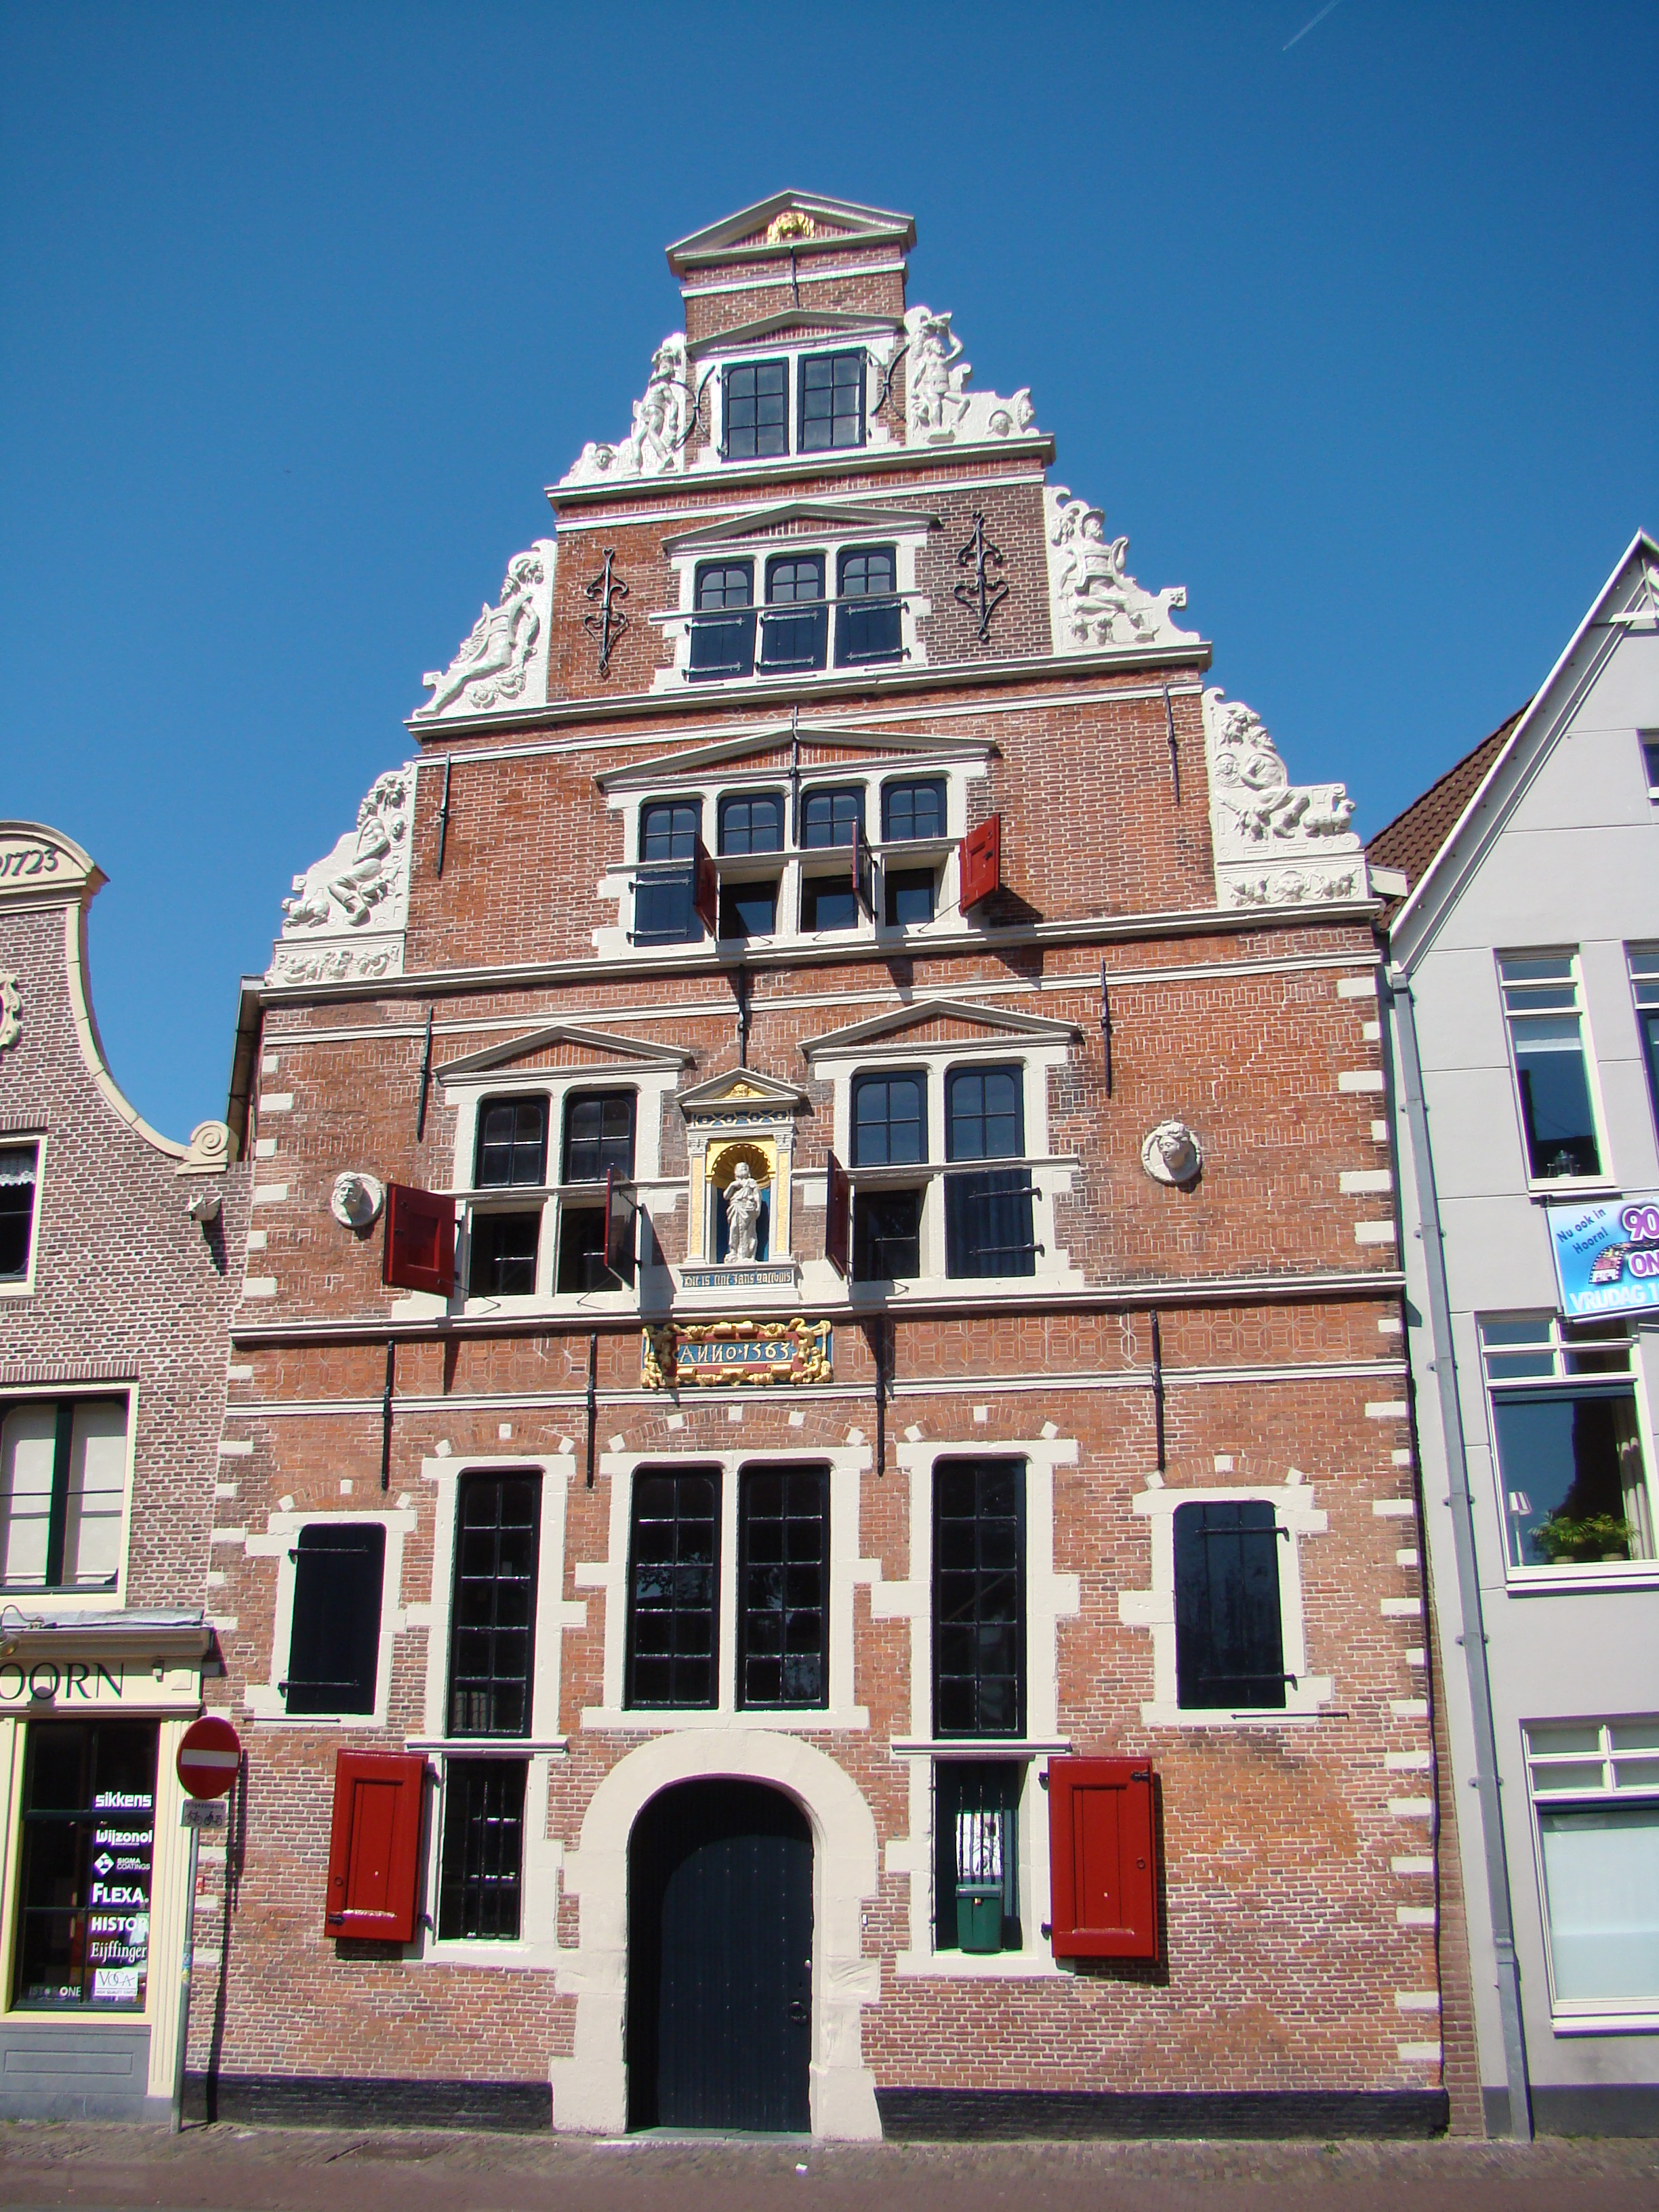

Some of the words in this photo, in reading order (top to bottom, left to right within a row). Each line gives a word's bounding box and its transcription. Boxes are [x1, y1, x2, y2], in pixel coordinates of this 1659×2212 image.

[1557, 1229, 1574, 1243] Nu
[1574, 1215, 1595, 1232] ook
[1593, 1208, 1607, 1220] in
[1572, 1226, 1609, 1254] Hoorn!
[0, 1662, 124, 1700] OORN
[95, 1791, 152, 1807] sikkens
[96, 1829, 153, 1846] Wijzonol
[91, 1916, 148, 1931] HISTOR
[90, 1940, 148, 1963] Eijffinger
